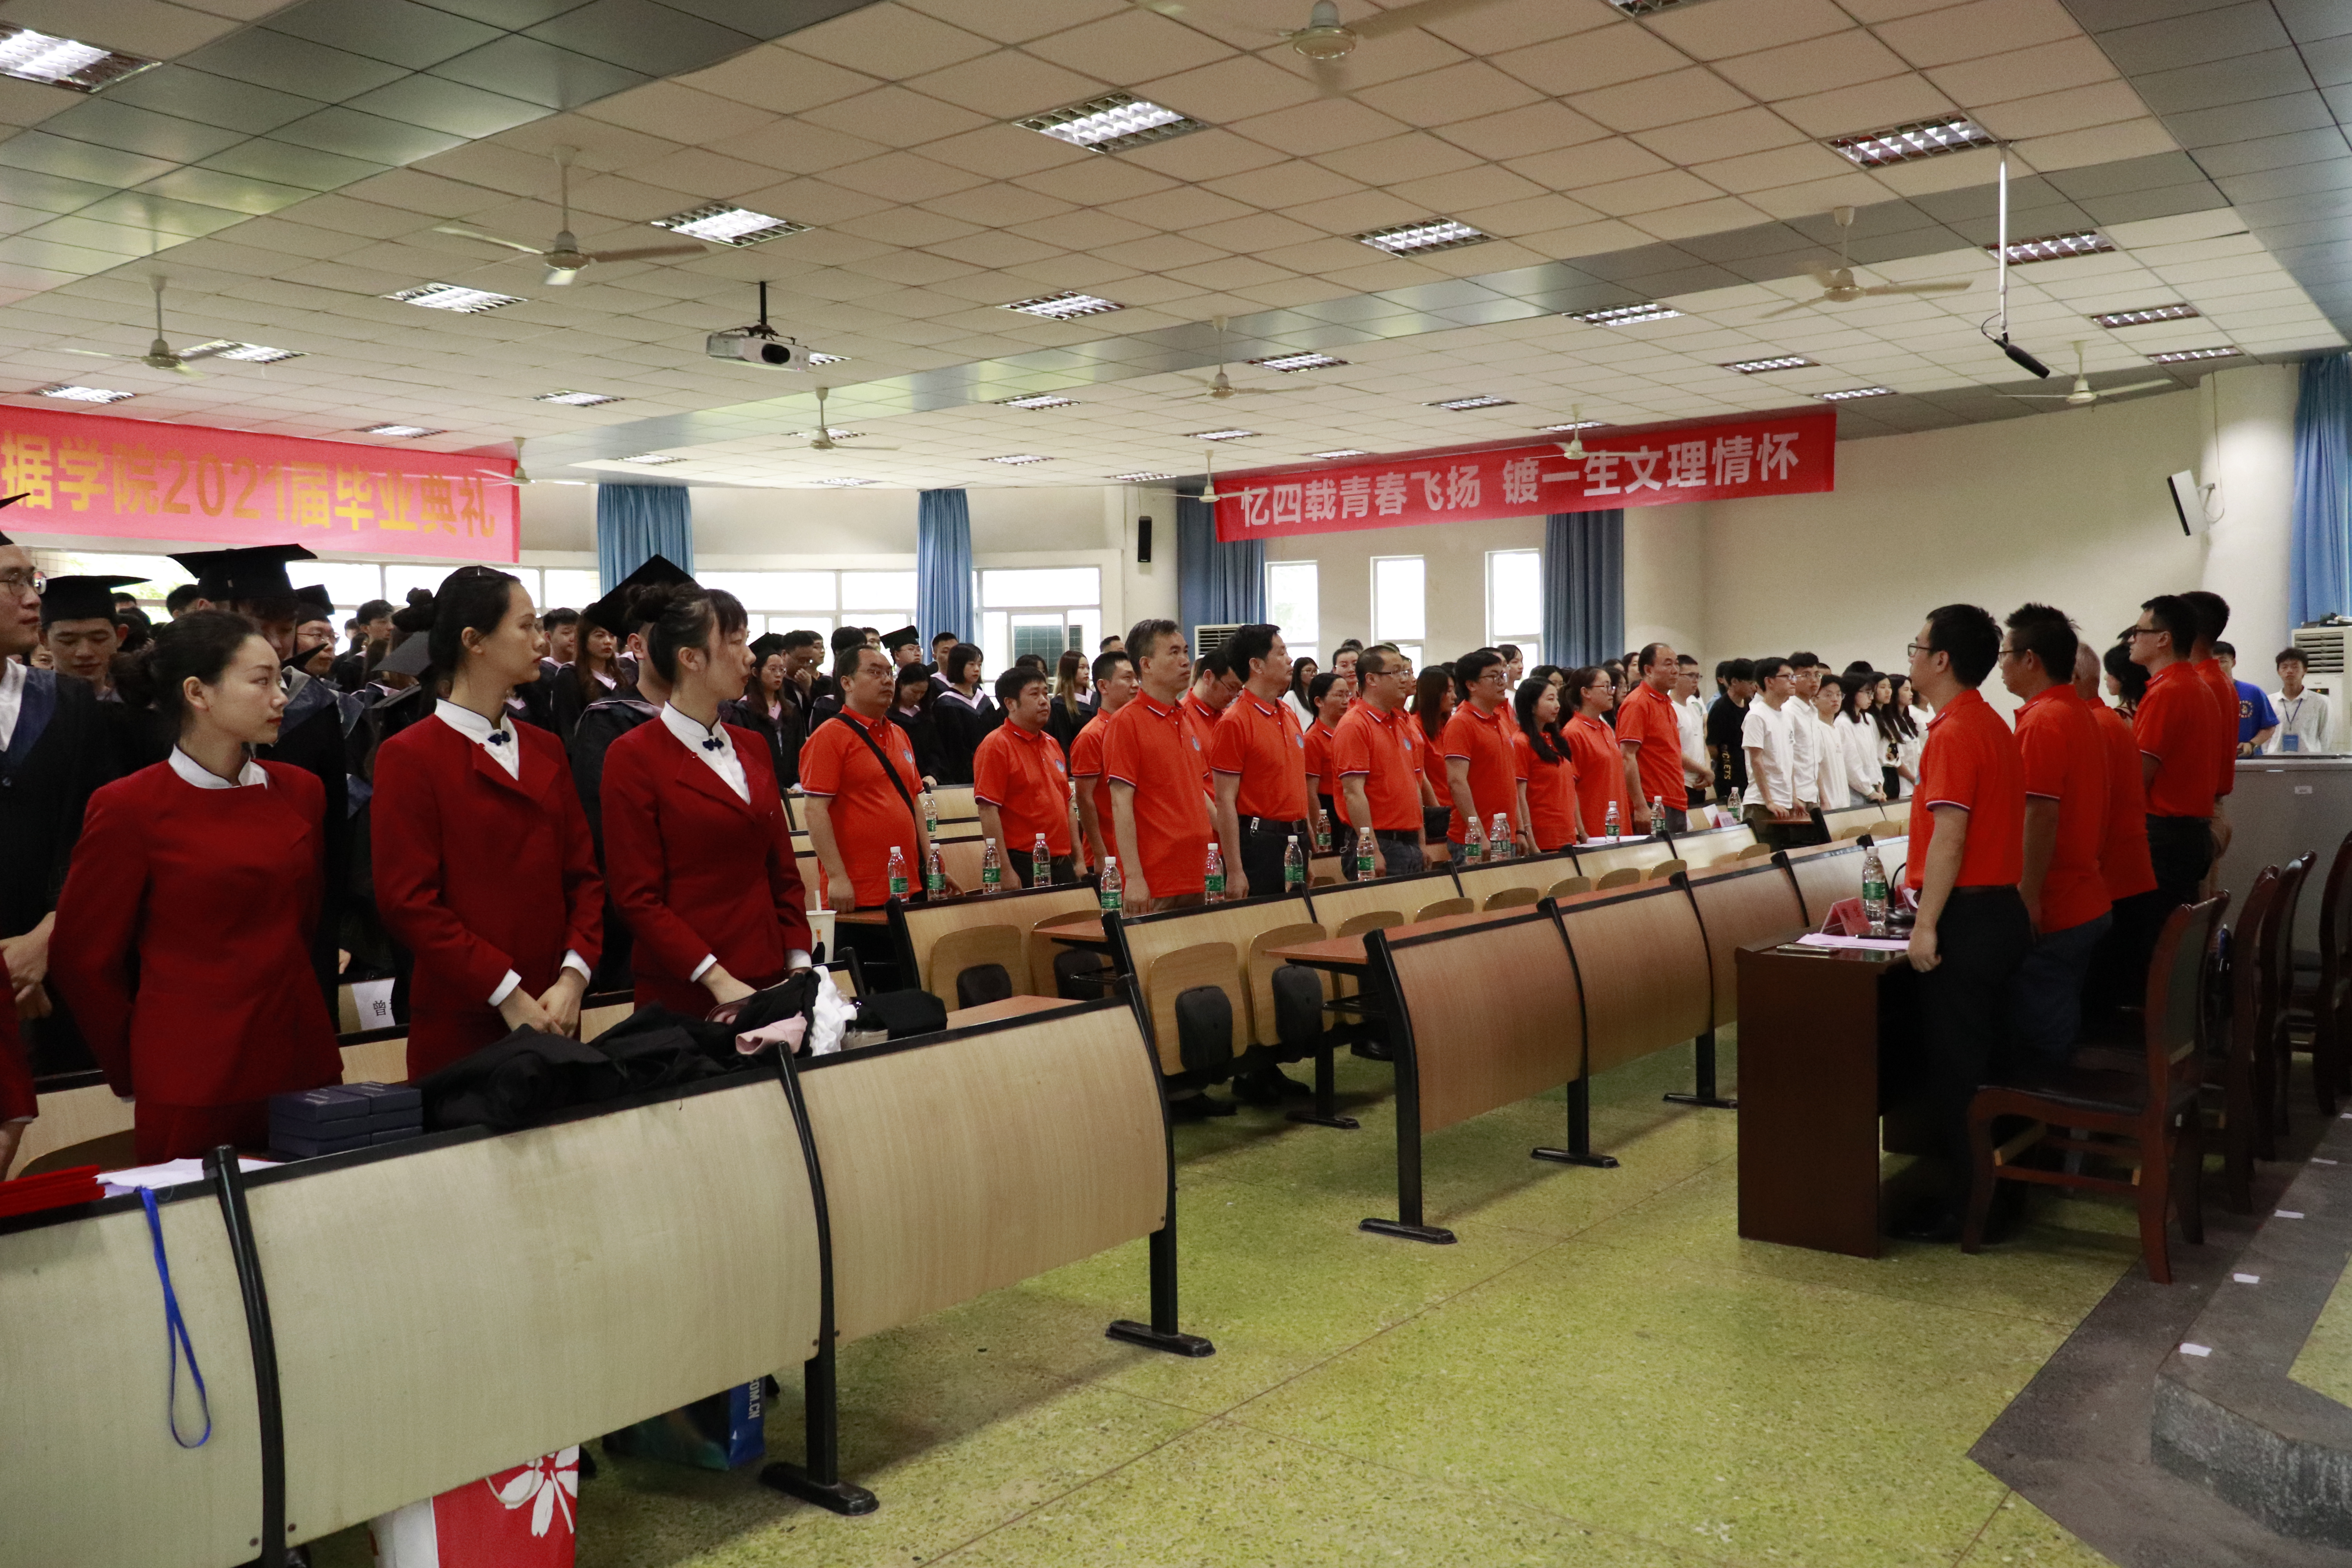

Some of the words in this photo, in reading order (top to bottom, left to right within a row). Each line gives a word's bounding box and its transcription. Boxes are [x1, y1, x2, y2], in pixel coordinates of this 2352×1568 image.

[1, 430, 495, 537] 据学院2021届毕业典礼
[1240, 465, 1480, 528] 忆四载青春飞扬
[1503, 432, 1799, 505] 镀一生文理情怀
[373, 1000, 392, 1016] 曾
[748, 1379, 760, 1419] OM.CN
